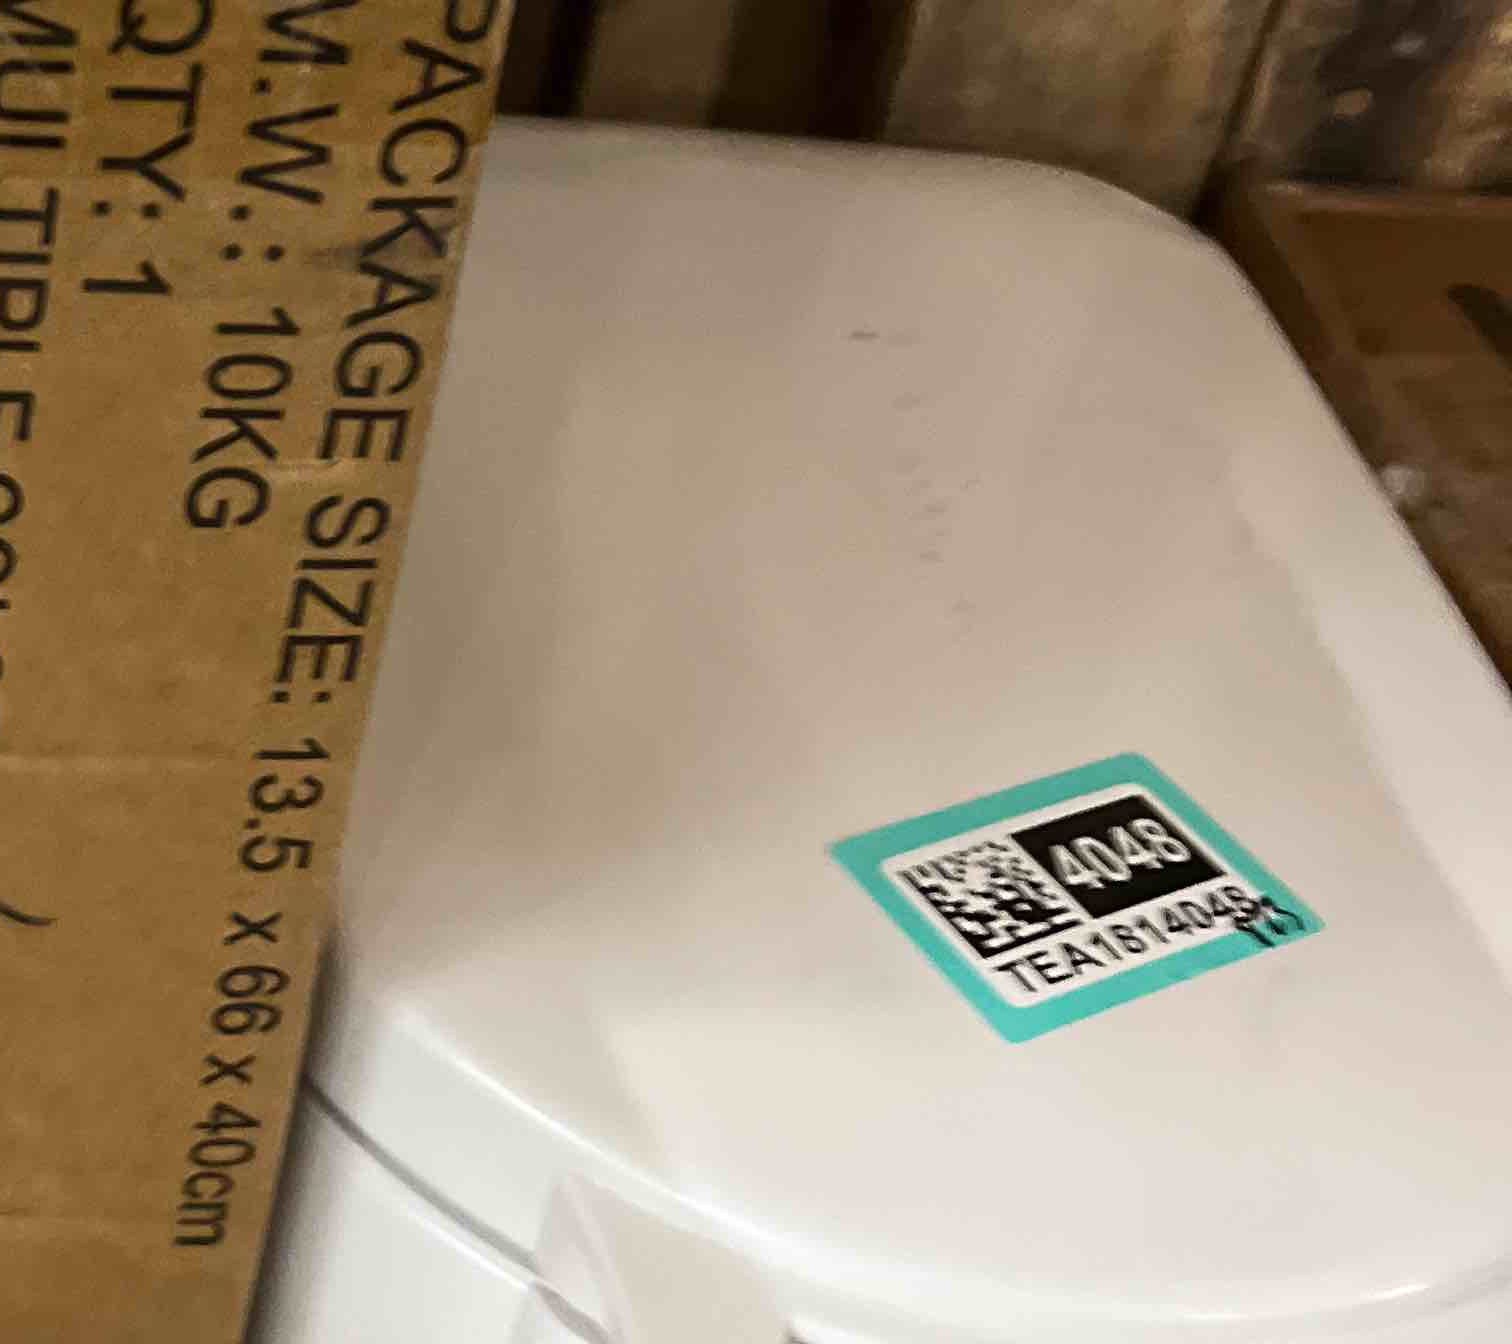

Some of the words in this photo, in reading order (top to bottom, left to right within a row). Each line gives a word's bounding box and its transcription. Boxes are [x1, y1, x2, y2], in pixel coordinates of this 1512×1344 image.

[81, 261, 174, 299] 1
[183, 307, 301, 531] 10KG
[268, 494, 392, 706] SIZE:
[234, 735, 332, 876] 13.5
[1050, 816, 1192, 891] 4048
[210, 963, 289, 1038] 66
[172, 1100, 264, 1248] 40cm
